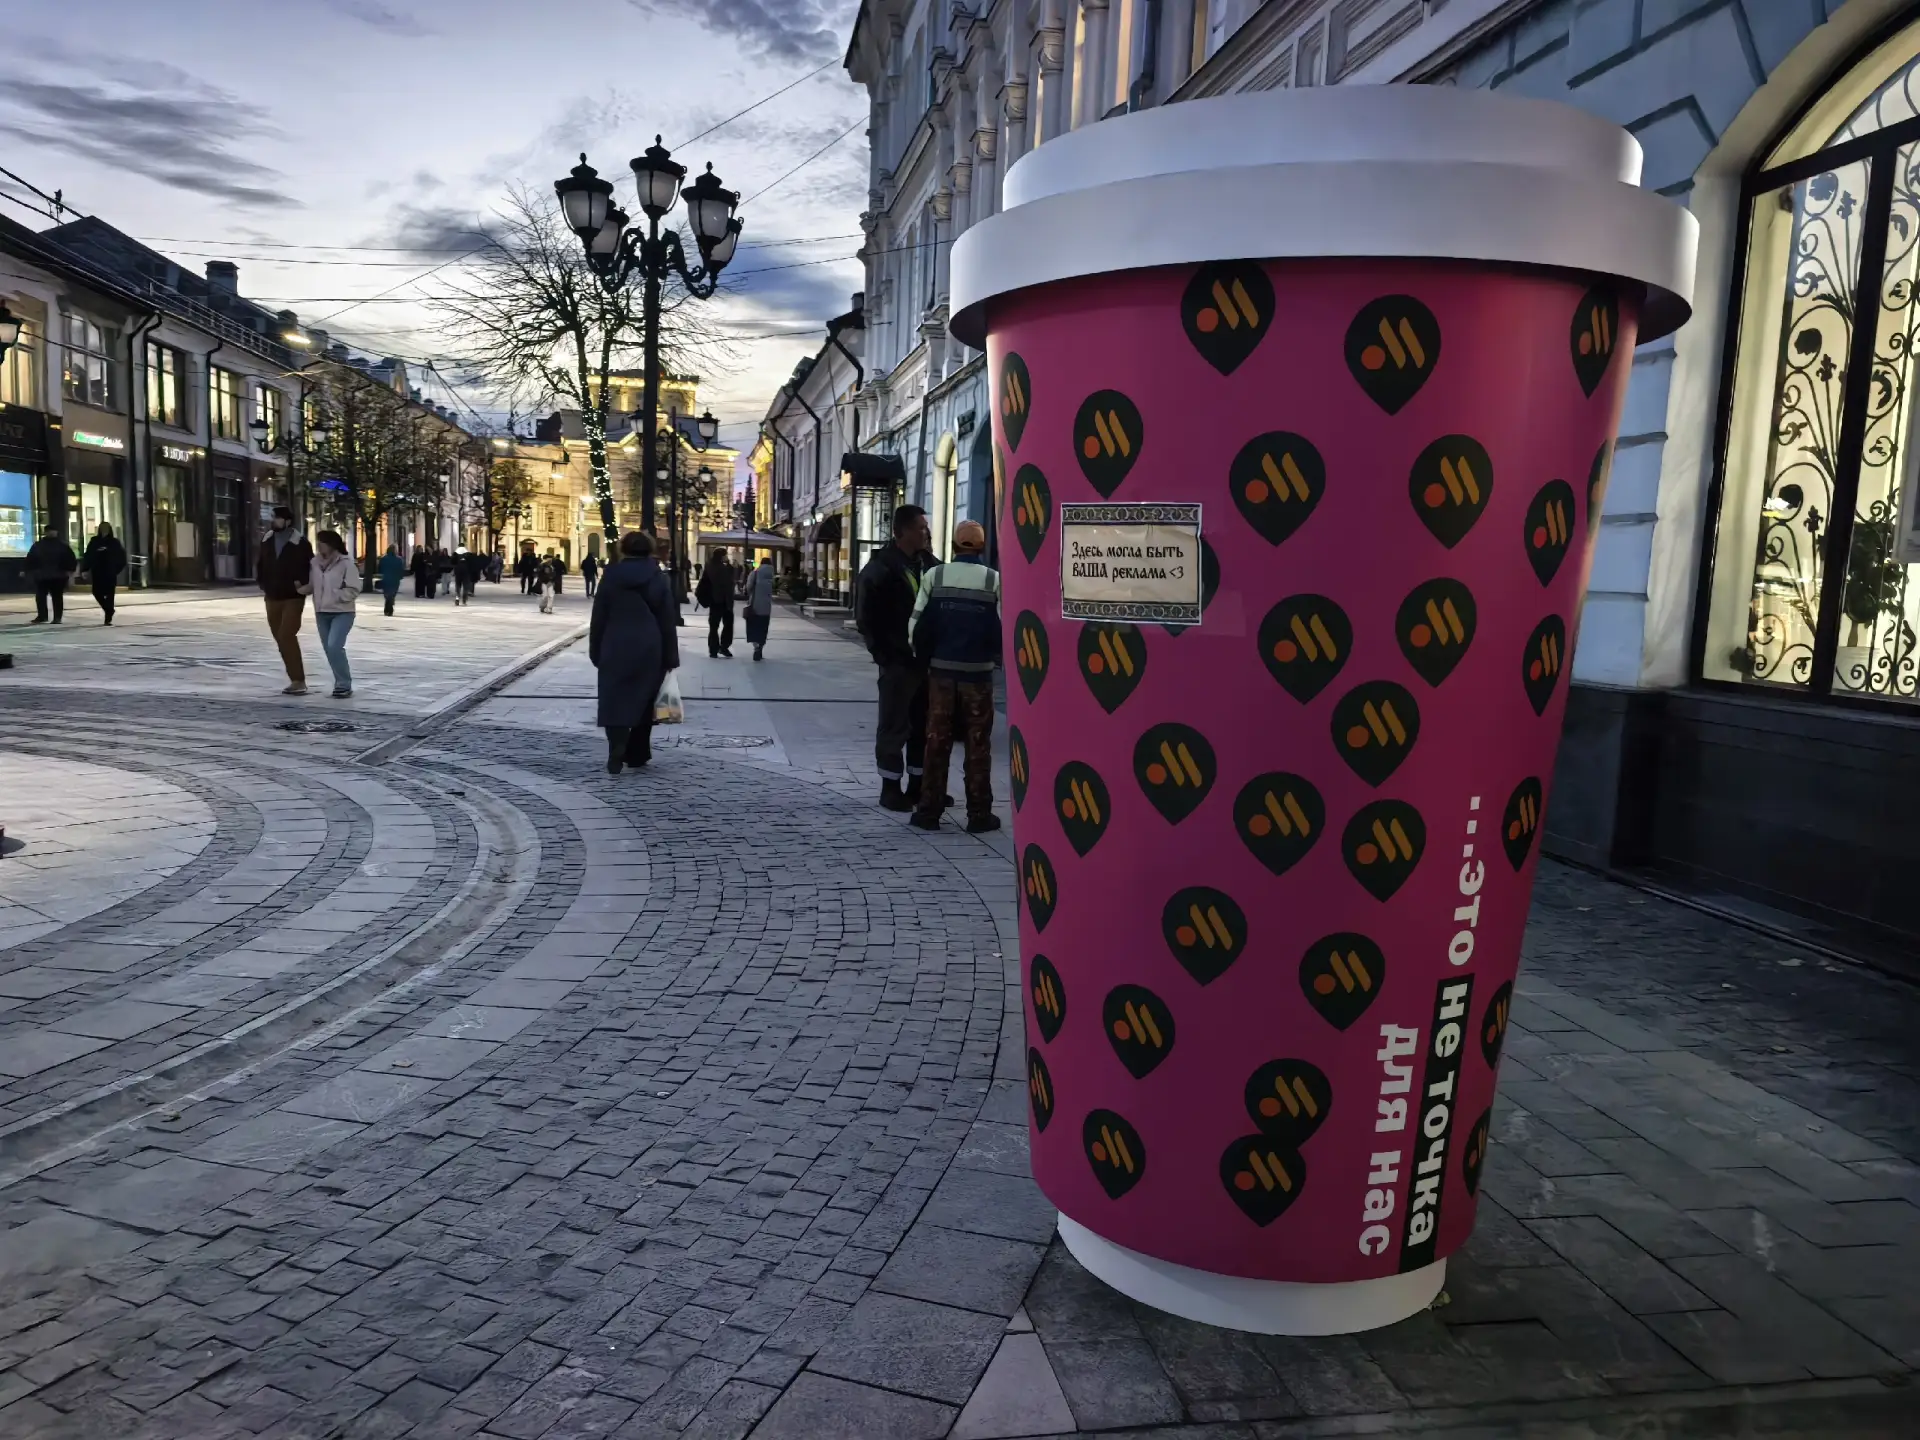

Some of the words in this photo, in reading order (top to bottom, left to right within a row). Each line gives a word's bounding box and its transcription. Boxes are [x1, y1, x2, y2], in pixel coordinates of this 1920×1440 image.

[1071, 541, 1104, 560] Здесь
[1106, 546, 1143, 559] могла
[1071, 562, 1109, 579] ВАША
[1112, 566, 1167, 583] реклама
[1169, 566, 1185, 580] <3
[1434, 982, 1469, 1058] не
[1375, 1022, 1420, 1134] для
[1357, 1149, 1403, 1257] нас
[1406, 1069, 1456, 1248] точка
